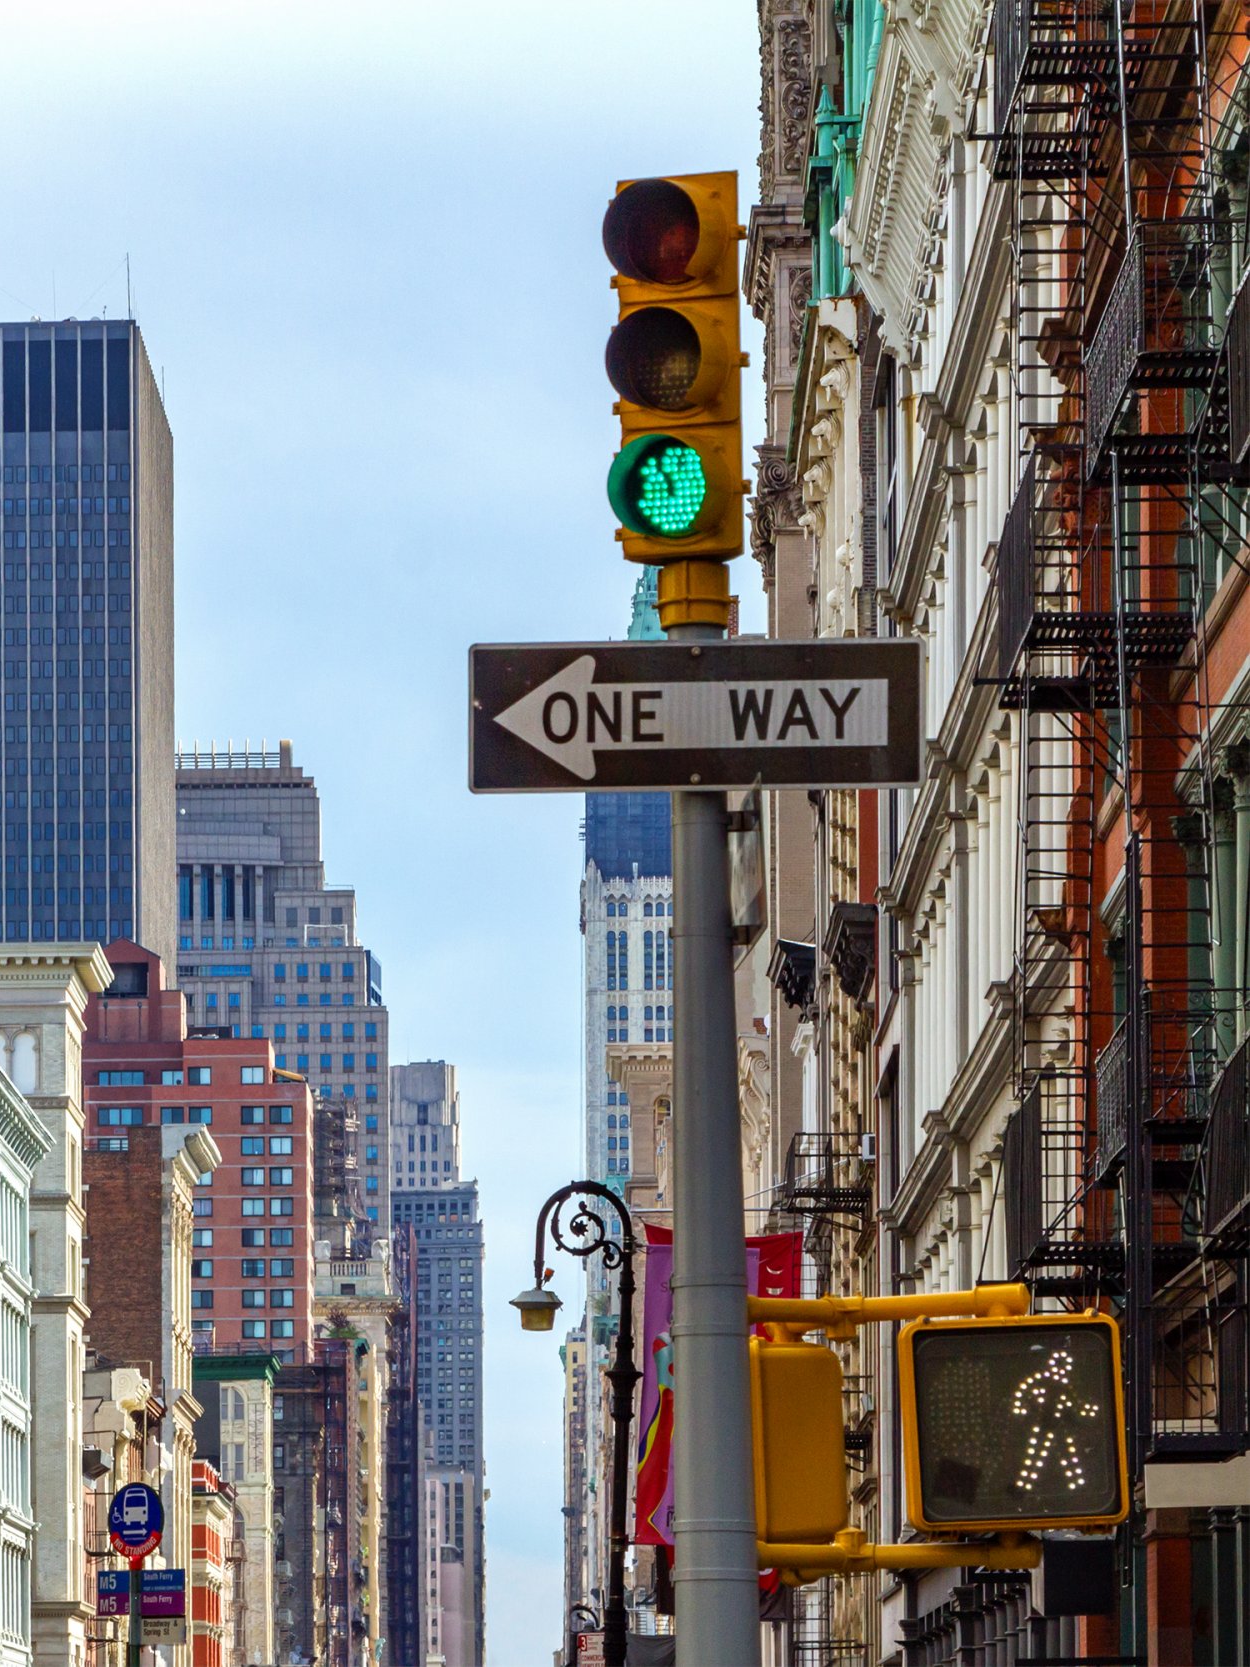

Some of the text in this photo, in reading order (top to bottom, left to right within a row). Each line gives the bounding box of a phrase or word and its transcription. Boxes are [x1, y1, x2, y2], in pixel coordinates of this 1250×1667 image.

[542, 687, 861, 744] ONE WAY
[114, 1537, 157, 1555] NO STANDING
[99, 1573, 117, 1590] M5
[143, 1571, 173, 1581] South Ferry
[99, 1596, 117, 1613] M5
[143, 1594, 172, 1605] South Ferry
[581, 1636, 587, 1651] 3
